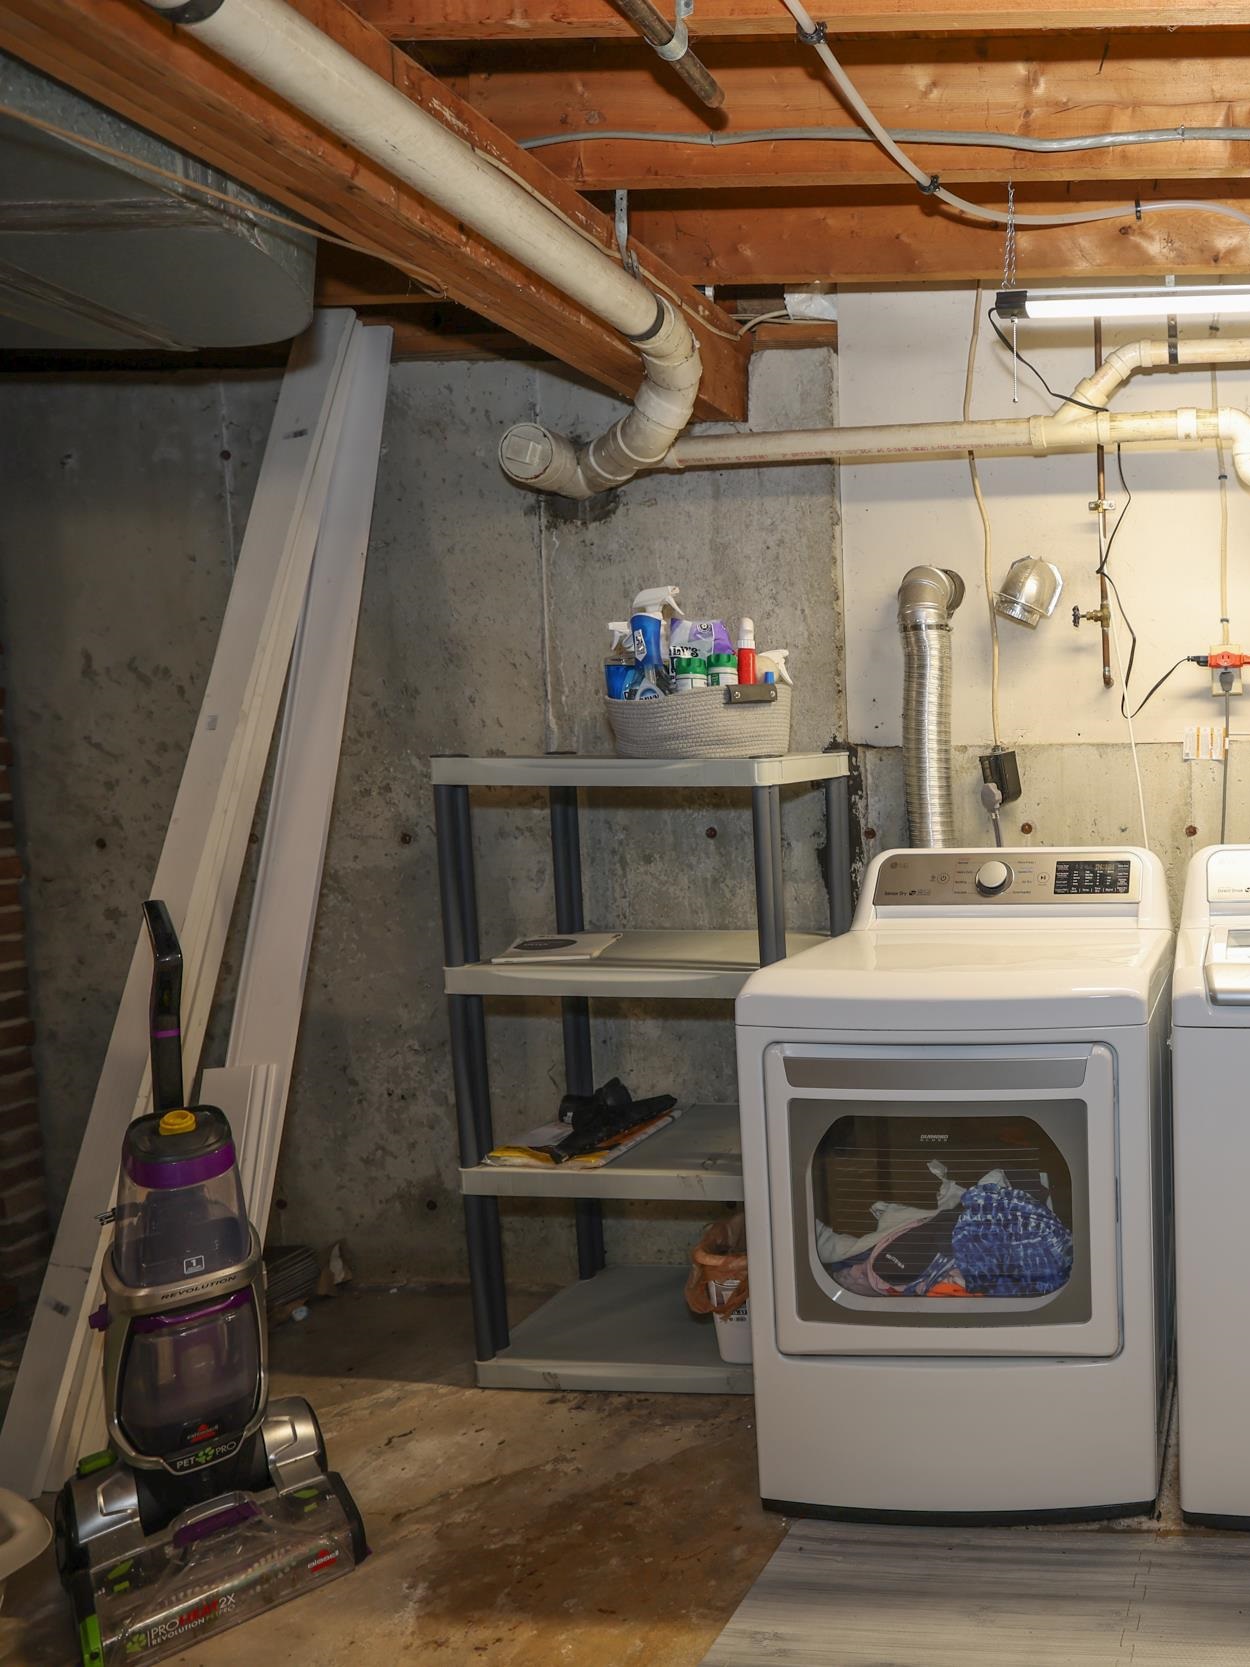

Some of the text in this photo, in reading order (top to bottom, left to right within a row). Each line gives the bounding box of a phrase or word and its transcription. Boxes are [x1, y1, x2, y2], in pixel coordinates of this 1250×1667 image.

[161, 1275, 237, 1300] REVOLUTION
[176, 1441, 237, 1469] PET PRO
[151, 1618, 205, 1646] REVOLUTION
